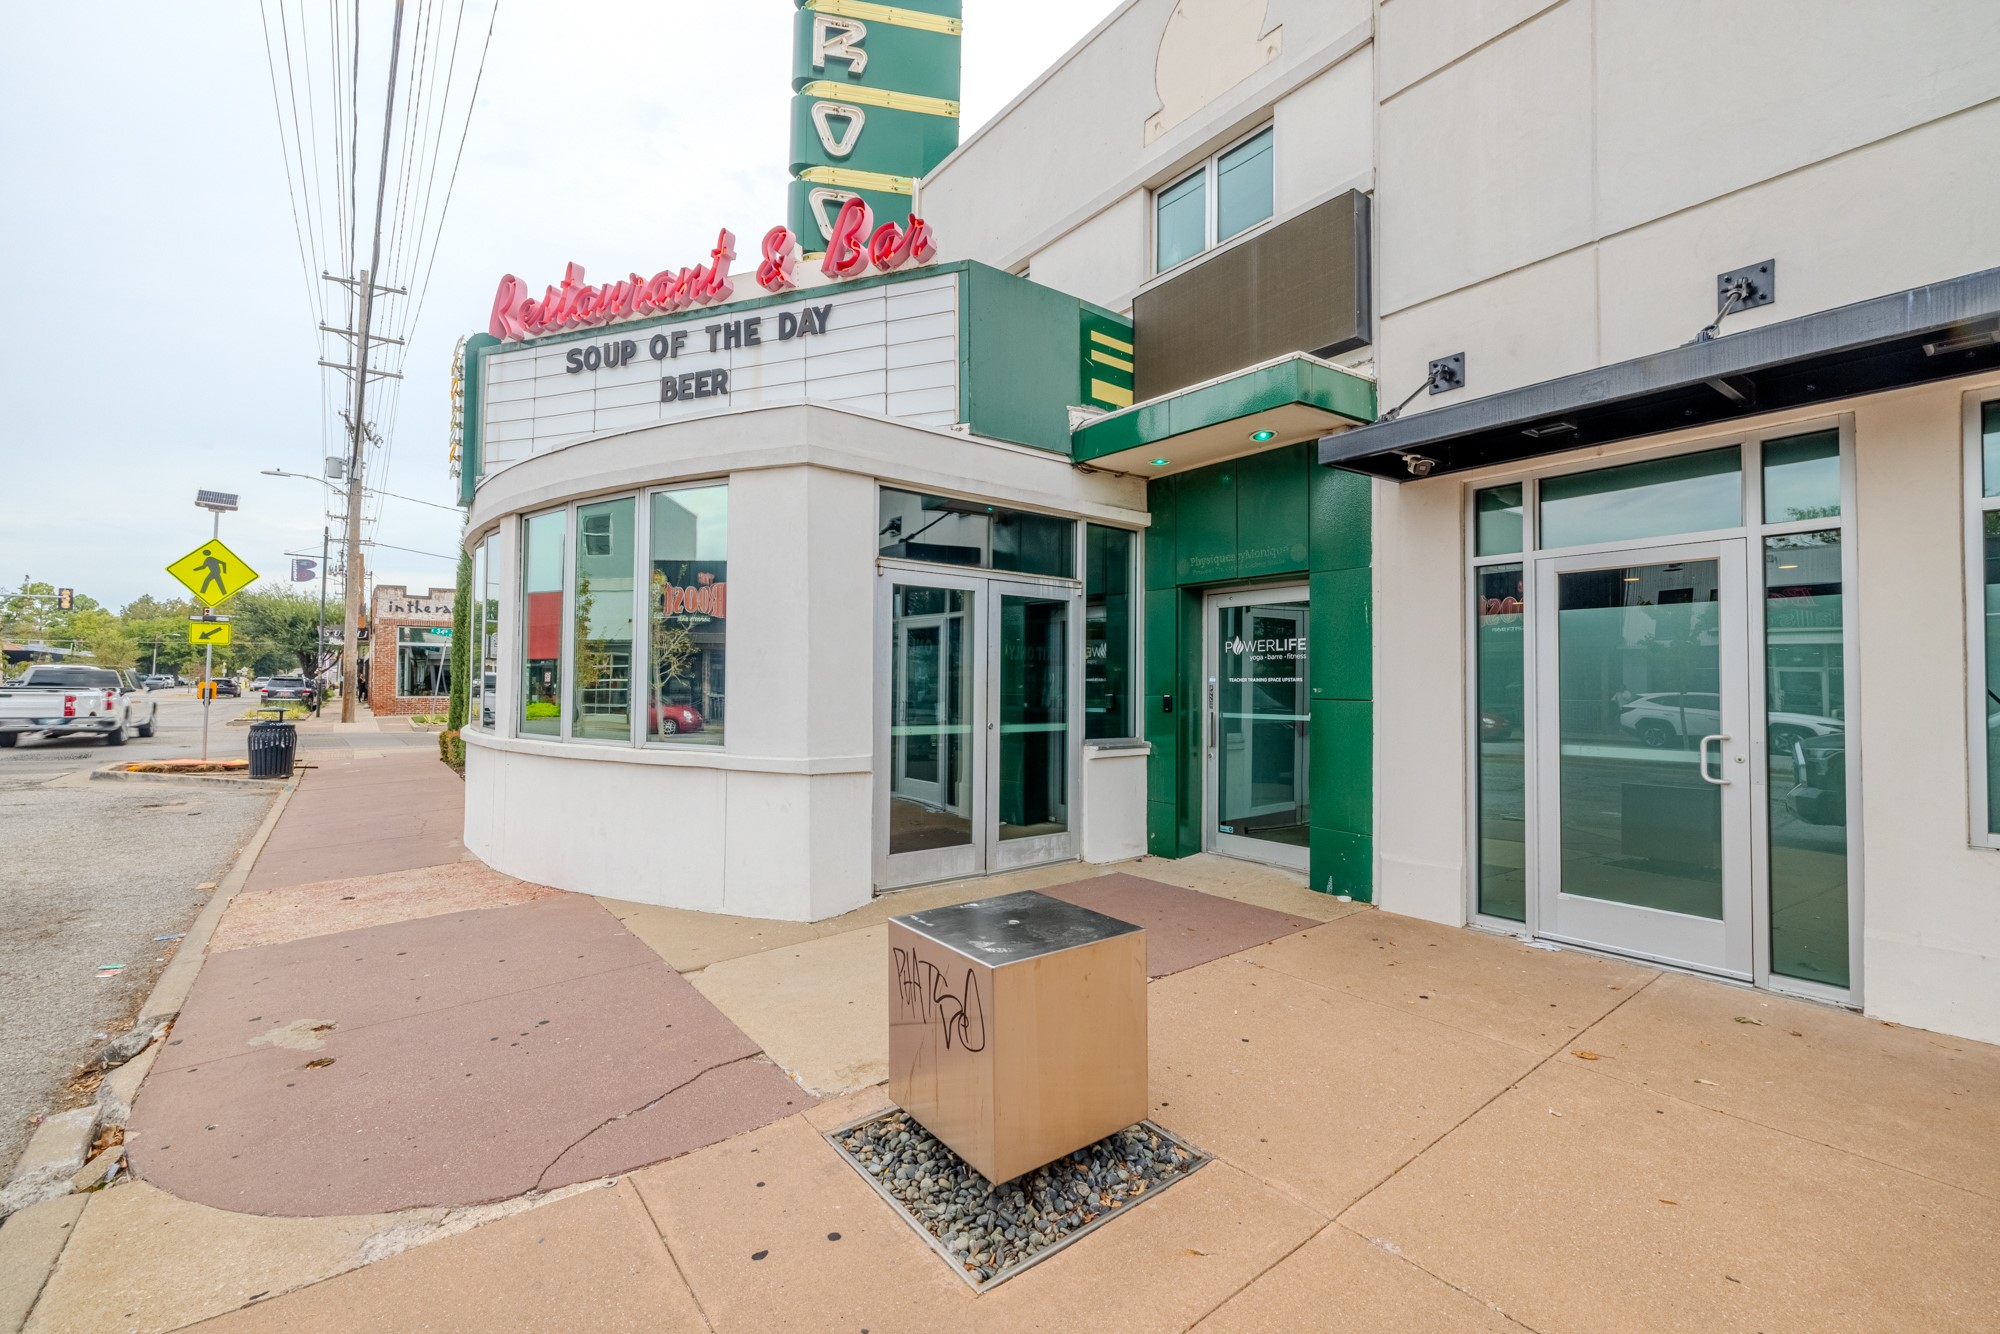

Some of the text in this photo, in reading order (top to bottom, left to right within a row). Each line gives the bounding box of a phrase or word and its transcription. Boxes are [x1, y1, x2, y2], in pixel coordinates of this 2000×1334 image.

[489, 197, 936, 342] Restaurant & Bar
[566, 304, 833, 374] SOUP OF THE DAY
[661, 368, 728, 403] BEER
